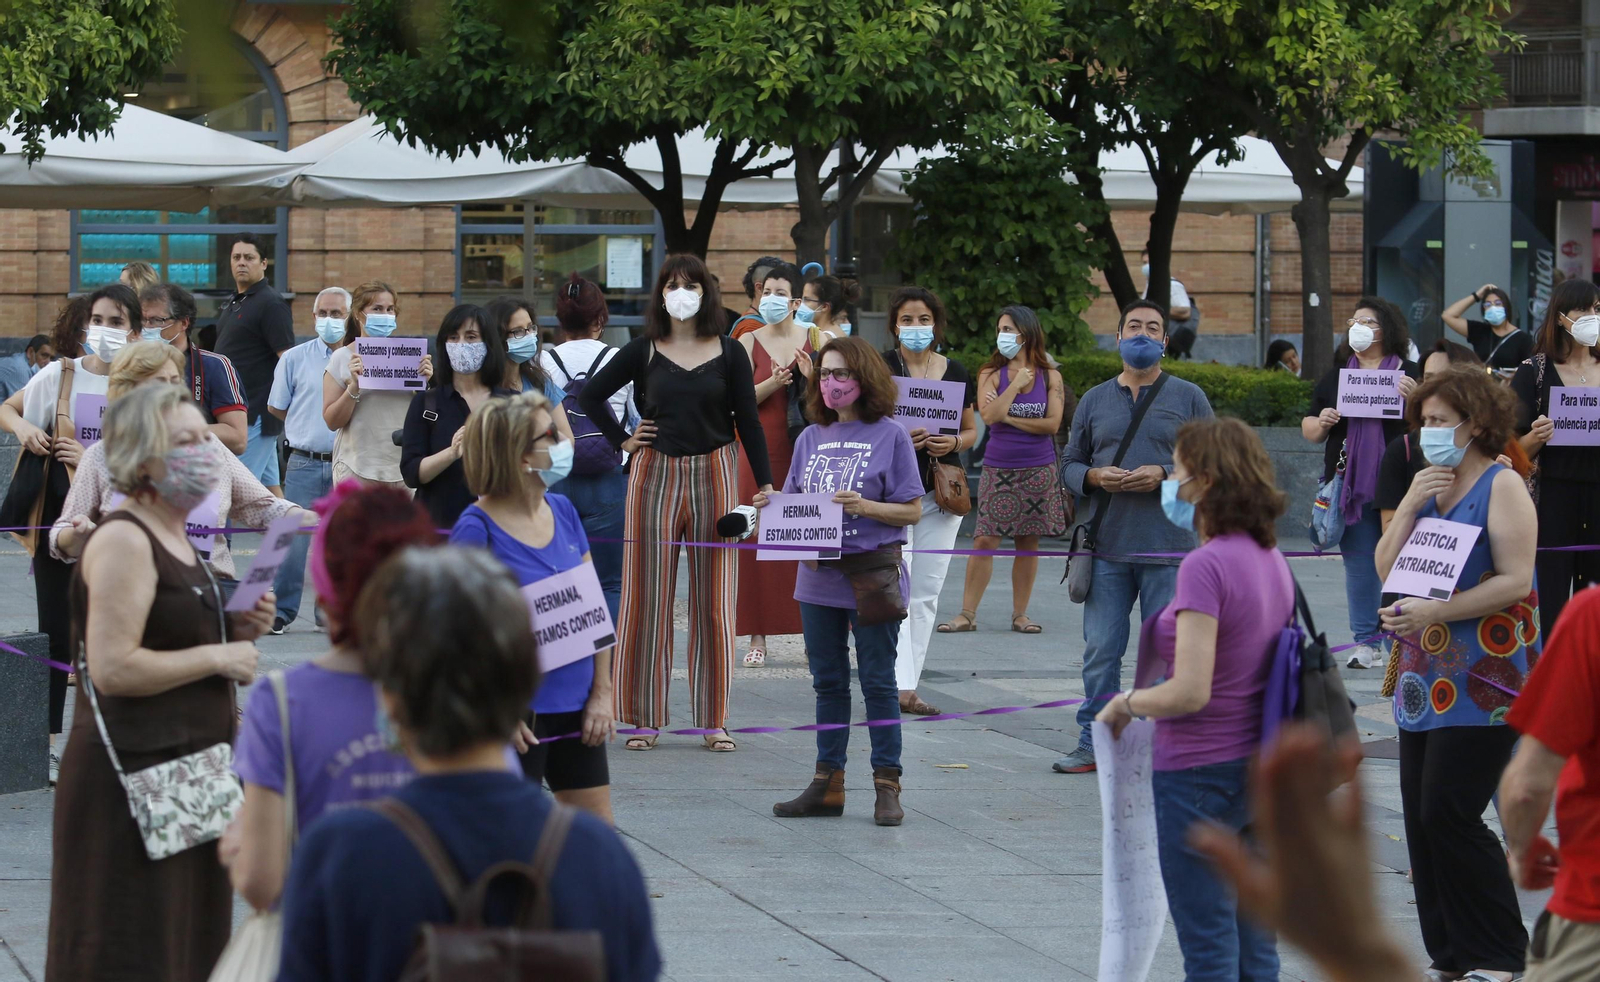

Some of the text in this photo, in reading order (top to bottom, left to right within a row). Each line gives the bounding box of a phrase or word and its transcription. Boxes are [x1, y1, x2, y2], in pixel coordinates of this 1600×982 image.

[358, 343, 422, 359] Rechazamos y condenamos
[370, 366, 393, 379] violencias
[394, 366, 419, 379] machistas
[1347, 374, 1395, 388] Para virus letal,
[908, 387, 945, 403] HERMANA,
[1342, 393, 1400, 407] violencia patriarcal
[1560, 393, 1598, 407] Para virus
[893, 405, 958, 421] ESTAMOS CONTIGO
[1553, 417, 1587, 430] violencia
[81, 427, 103, 441] ESTA
[782, 504, 822, 520] HERMANA,
[186, 522, 210, 539] TIGO
[765, 526, 838, 541] ESTAMOS CONTIGO
[1410, 531, 1458, 552] JUSTICIA
[1394, 556, 1455, 579] PATRIARCAL
[534, 585, 583, 615] HERMANA,
[534, 606, 606, 646] TAMOS CONTIGO
